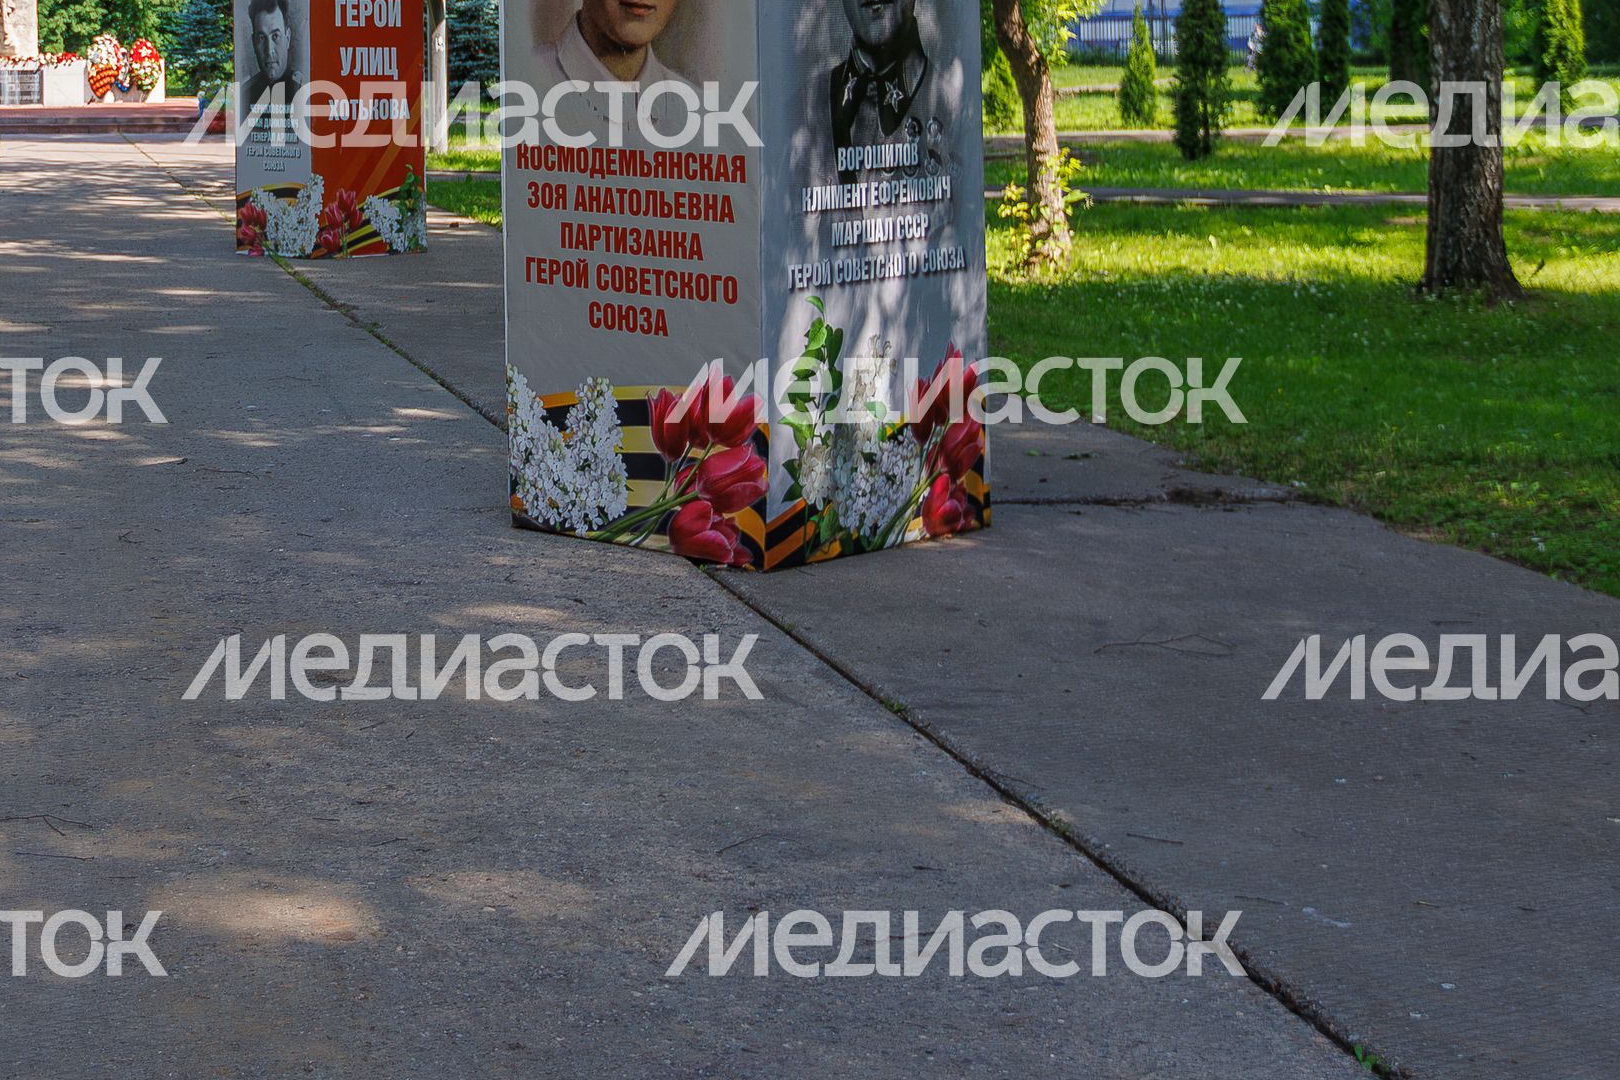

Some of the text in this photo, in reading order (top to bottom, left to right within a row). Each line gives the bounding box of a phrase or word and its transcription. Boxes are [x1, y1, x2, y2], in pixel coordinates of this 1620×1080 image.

[340, 47, 398, 80] УЛИЦ
[328, 98, 410, 120] ХОТЬКОВА
[516, 143, 747, 184] КОСМОДЕМЬЯНСКАЯ
[837, 142, 920, 171] ВОРОШИЛОВ
[527, 181, 735, 224] ЗОЯ АНАТОЛЬЕВНА
[802, 175, 951, 212] КЛИМЕНТ ЕФРЕМОВИЧ
[560, 221, 704, 261] ПАРТИЗАНКА
[831, 212, 929, 248] МАРШАЛ СССР
[525, 256, 738, 305] ГЕРОЙ СОВЕТСКОГО
[787, 245, 966, 290] ГЕРОЙ СОВЕТСКОГО СОЮЗА
[588, 301, 669, 337] СОЮЗА
